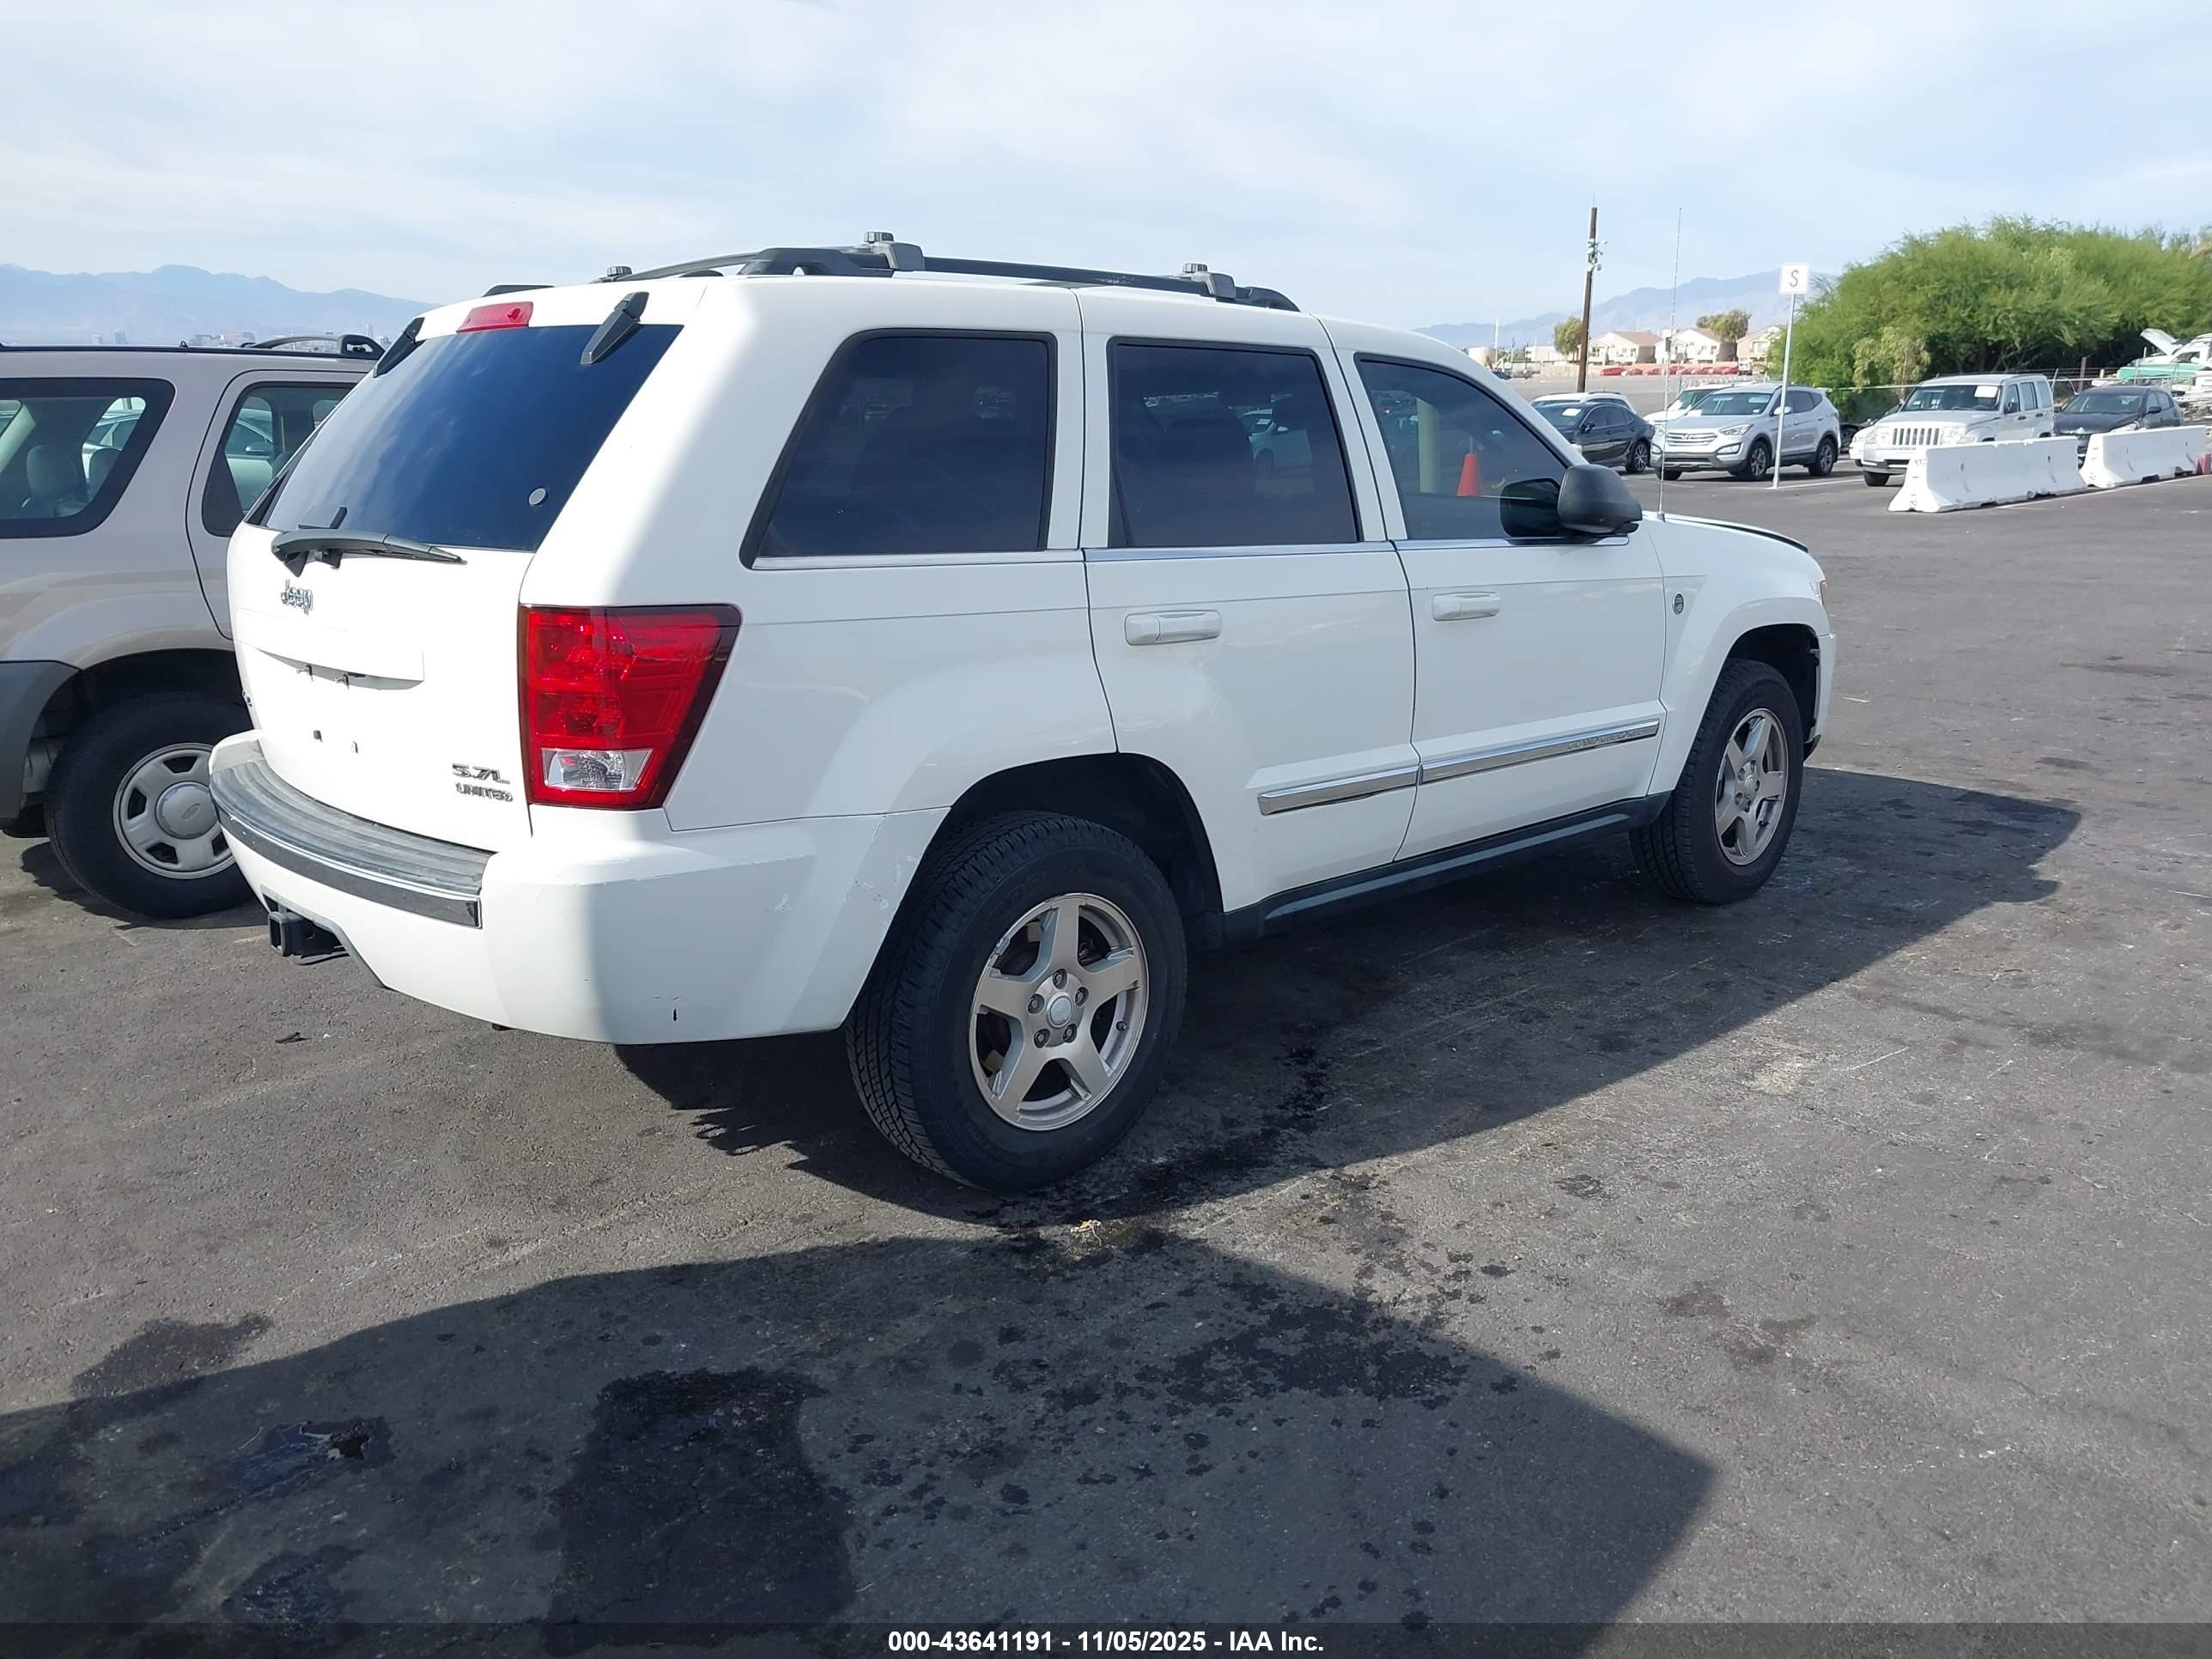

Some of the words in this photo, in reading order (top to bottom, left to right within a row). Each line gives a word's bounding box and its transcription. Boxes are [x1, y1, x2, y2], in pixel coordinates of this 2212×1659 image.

[1789, 269, 1800, 288] S
[281, 579, 313, 616] Jeep
[452, 763, 511, 785] 5.7L
